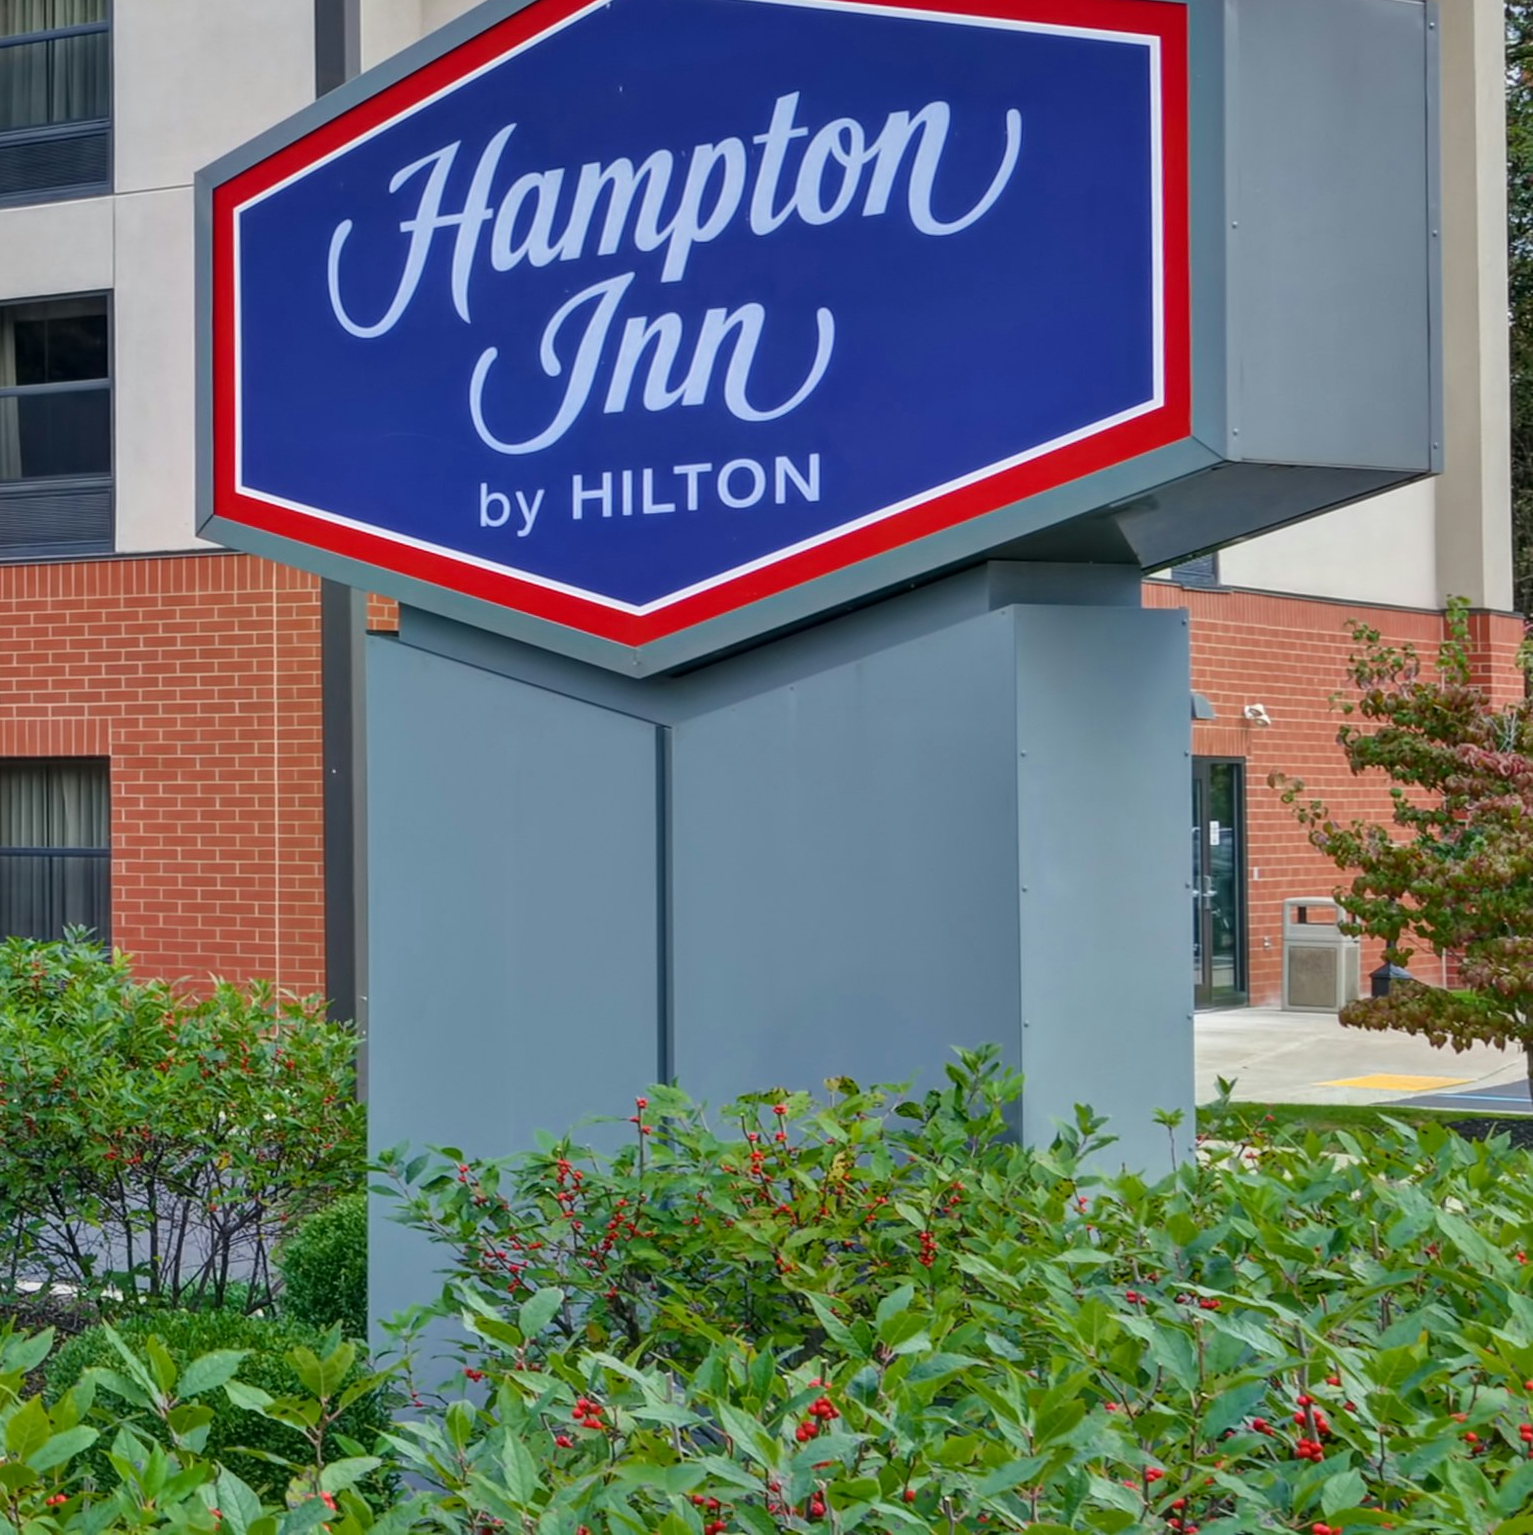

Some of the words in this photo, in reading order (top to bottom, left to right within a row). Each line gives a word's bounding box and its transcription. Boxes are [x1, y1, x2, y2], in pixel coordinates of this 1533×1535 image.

[327, 91, 1022, 339] Hampton
[469, 271, 835, 455] Inn
[478, 480, 544, 537] by
[571, 452, 821, 522] HILTON
